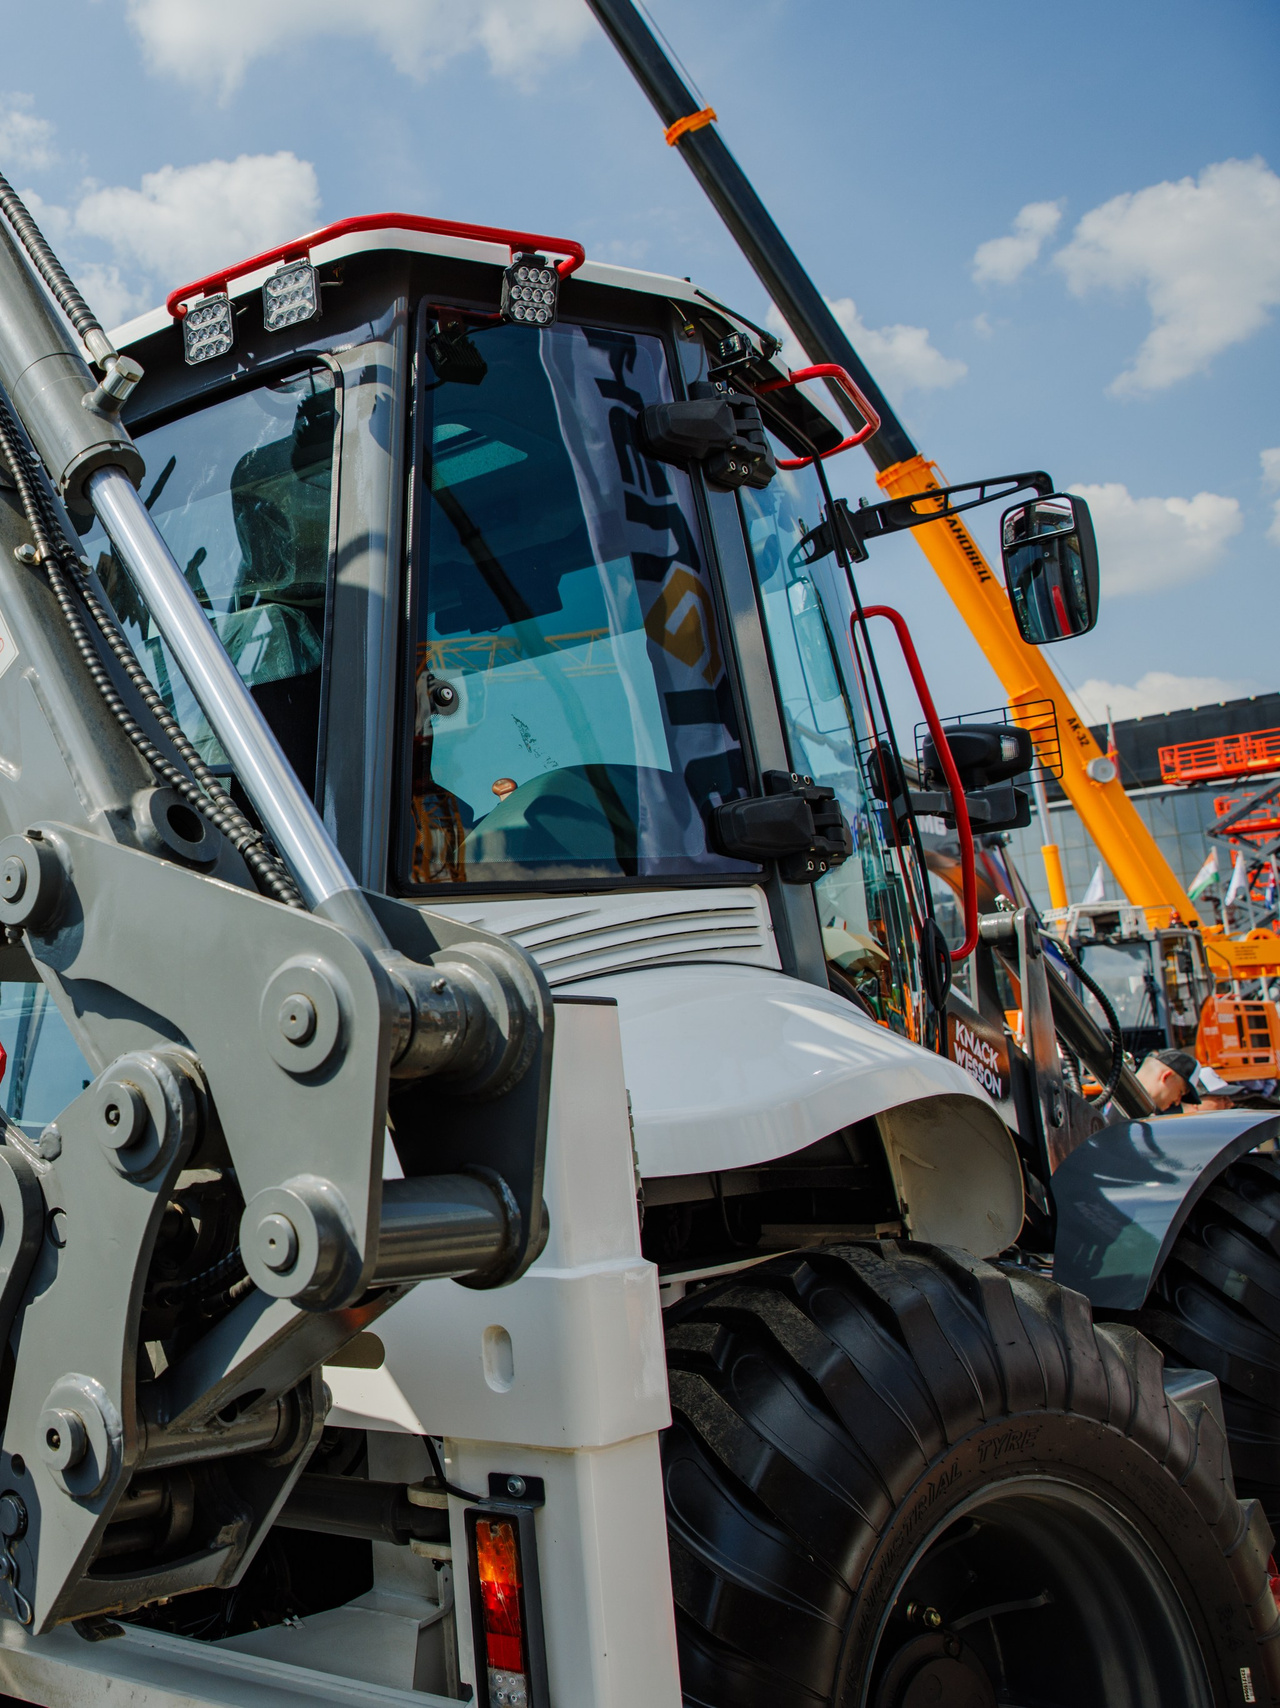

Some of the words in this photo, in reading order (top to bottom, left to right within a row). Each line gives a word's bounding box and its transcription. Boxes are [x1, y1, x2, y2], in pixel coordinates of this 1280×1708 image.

[953, 1041, 1002, 1098] WESSON
[955, 1019, 999, 1073] KNACK
[977, 1427, 1040, 1464] TYRE
